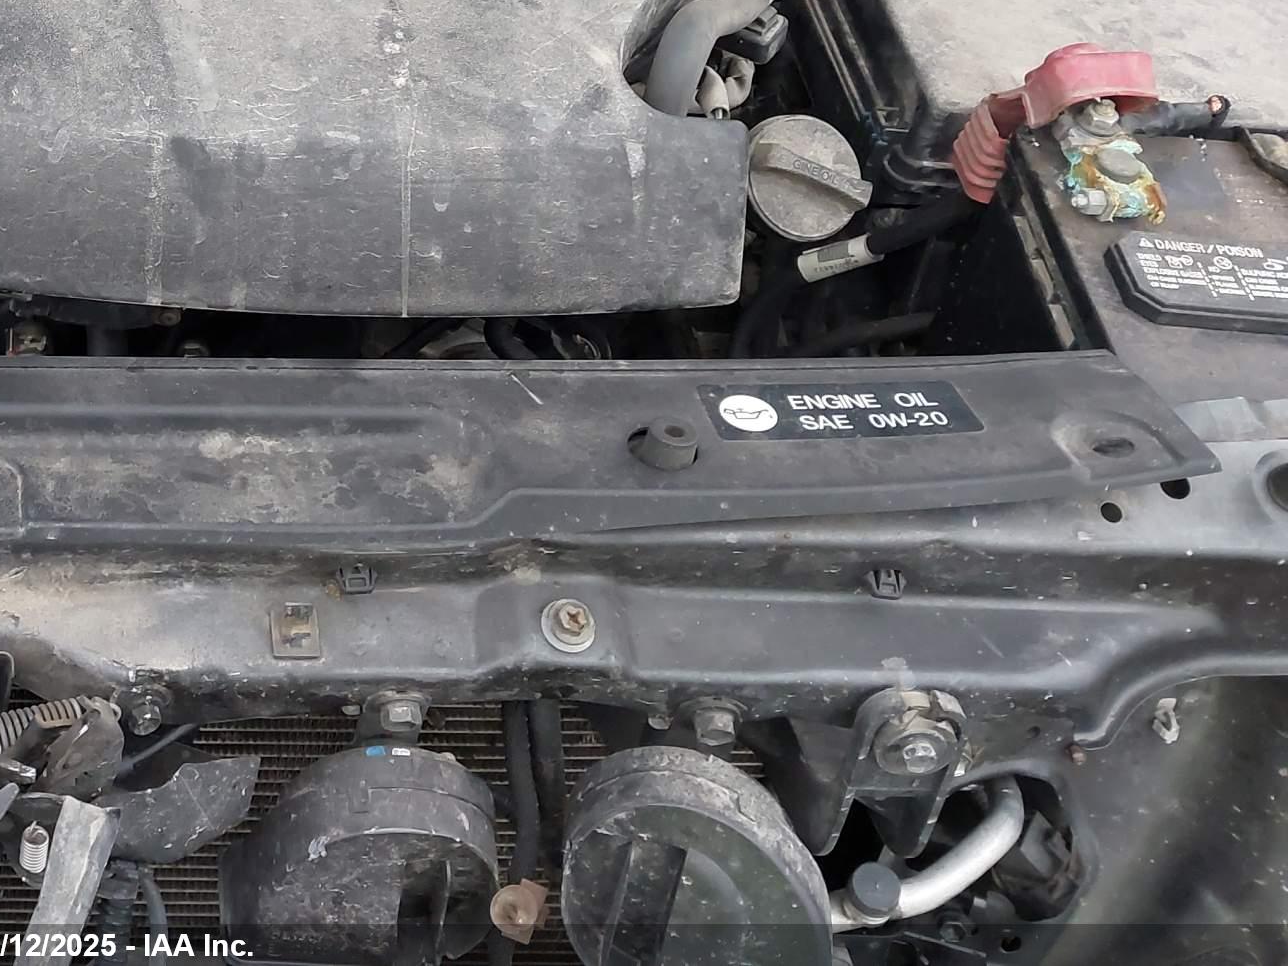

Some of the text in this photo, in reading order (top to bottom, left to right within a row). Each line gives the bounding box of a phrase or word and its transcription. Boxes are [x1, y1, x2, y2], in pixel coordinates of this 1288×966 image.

[1154, 239, 1205, 254] DANGER
[1216, 244, 1264, 258] POISON
[787, 392, 939, 410] ENGINE OIL
[799, 411, 948, 430] SAE 0W-20
